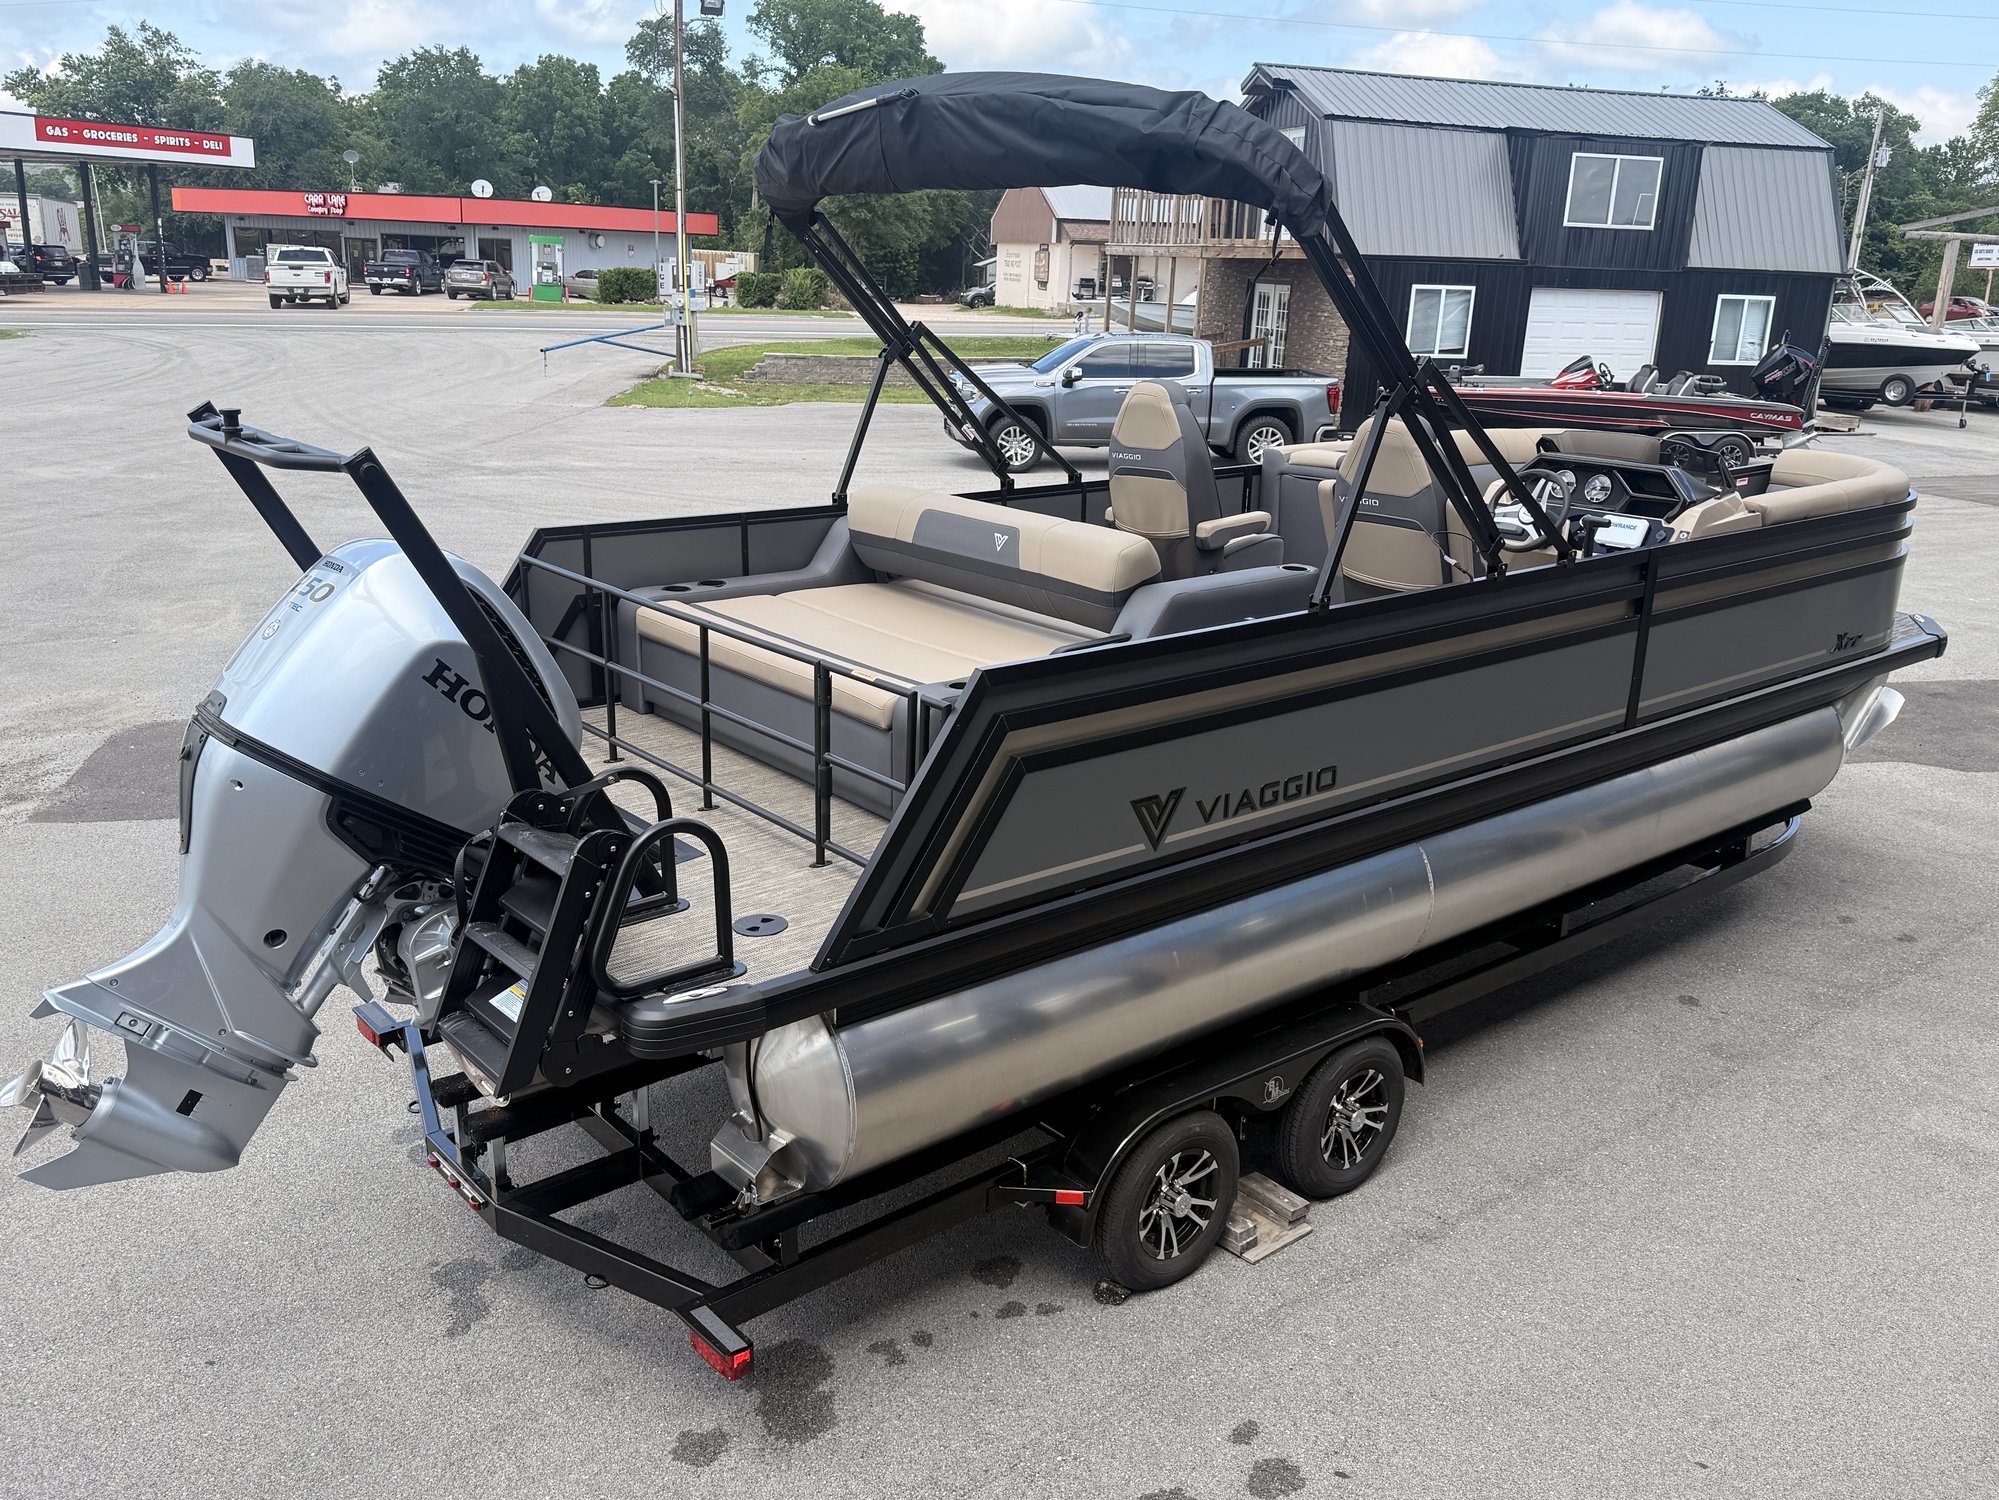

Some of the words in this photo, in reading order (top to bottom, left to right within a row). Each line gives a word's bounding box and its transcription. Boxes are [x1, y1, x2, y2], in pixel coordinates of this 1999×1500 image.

[45, 125, 69, 137] GAS
[82, 129, 138, 143] GROCERIES
[154, 135, 191, 147] SPIRITS
[203, 140, 223, 150] DELI
[304, 194, 325, 205] CARR
[327, 194, 346, 207] LANE
[1750, 412, 1793, 422] CAYMAS
[1111, 452, 1142, 461] VIAGGIO
[1338, 495, 1379, 506] VGIO
[1611, 522, 1638, 531] OWRANCE
[323, 560, 344, 573] HONDA
[1195, 765, 1337, 824] VIAGGIO
